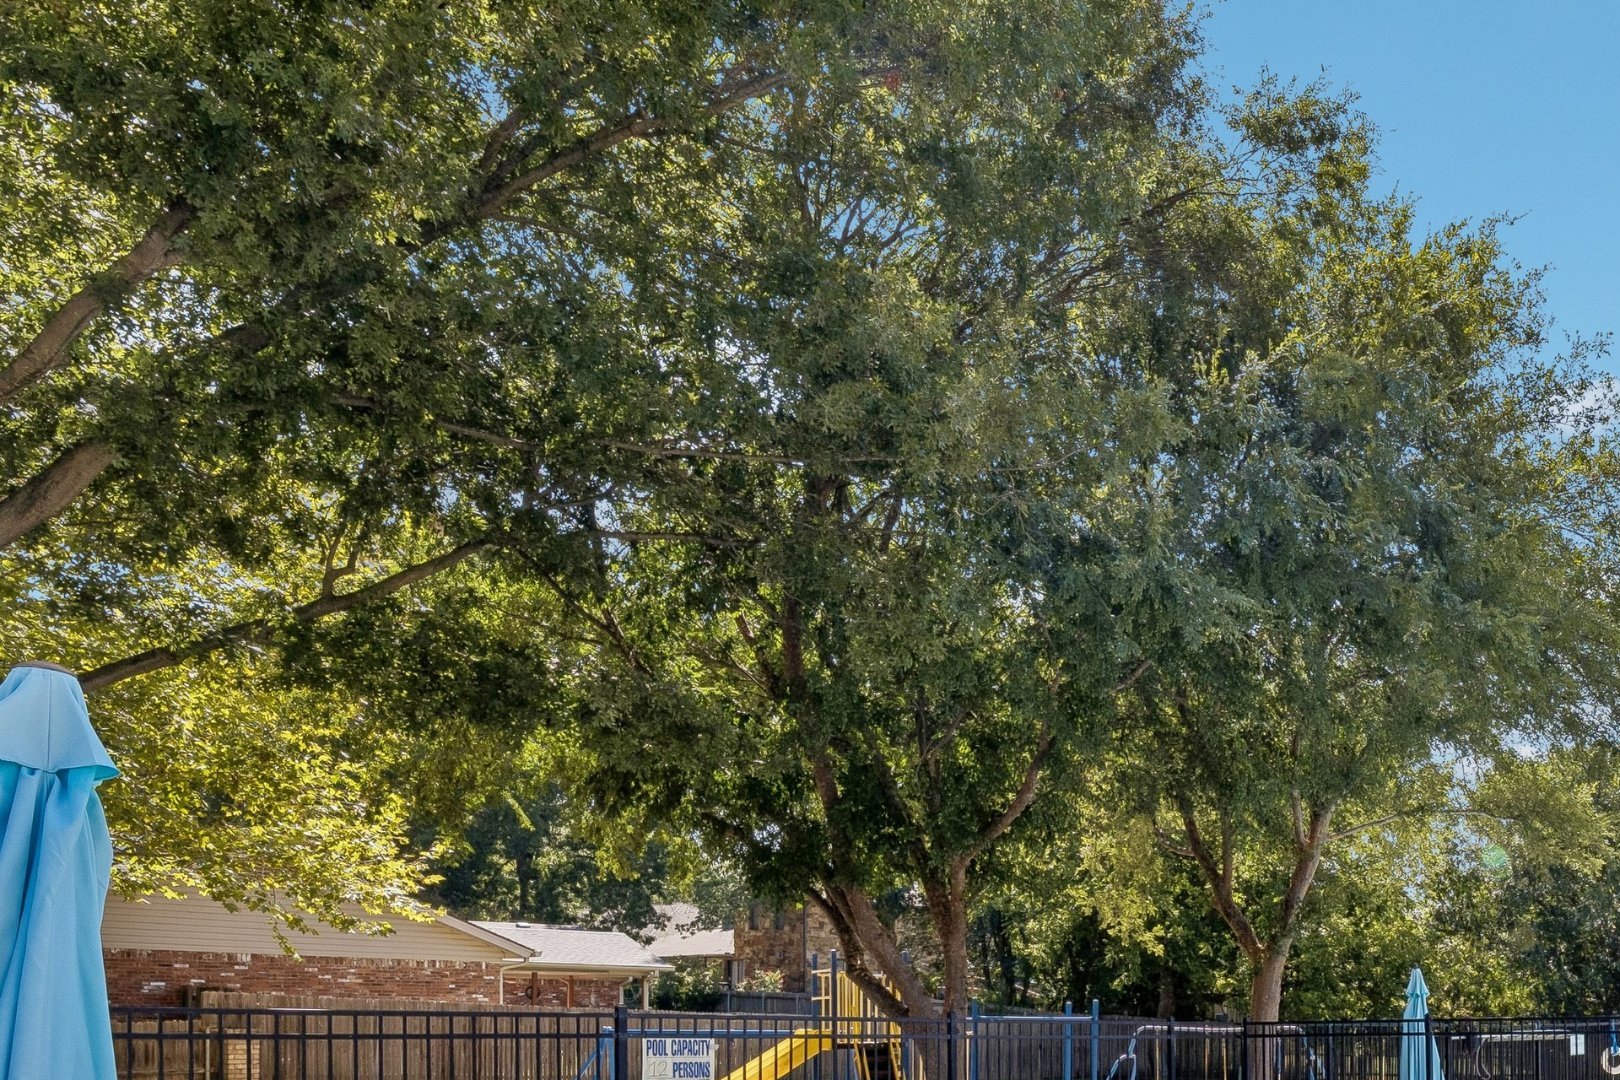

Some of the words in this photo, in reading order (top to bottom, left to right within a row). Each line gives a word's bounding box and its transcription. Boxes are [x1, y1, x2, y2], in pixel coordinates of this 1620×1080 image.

[646, 1039, 668, 1056] POOL
[671, 1039, 711, 1056] CAPACITY
[648, 1060, 669, 1078] 12
[672, 1061, 711, 1079] PERSONS
